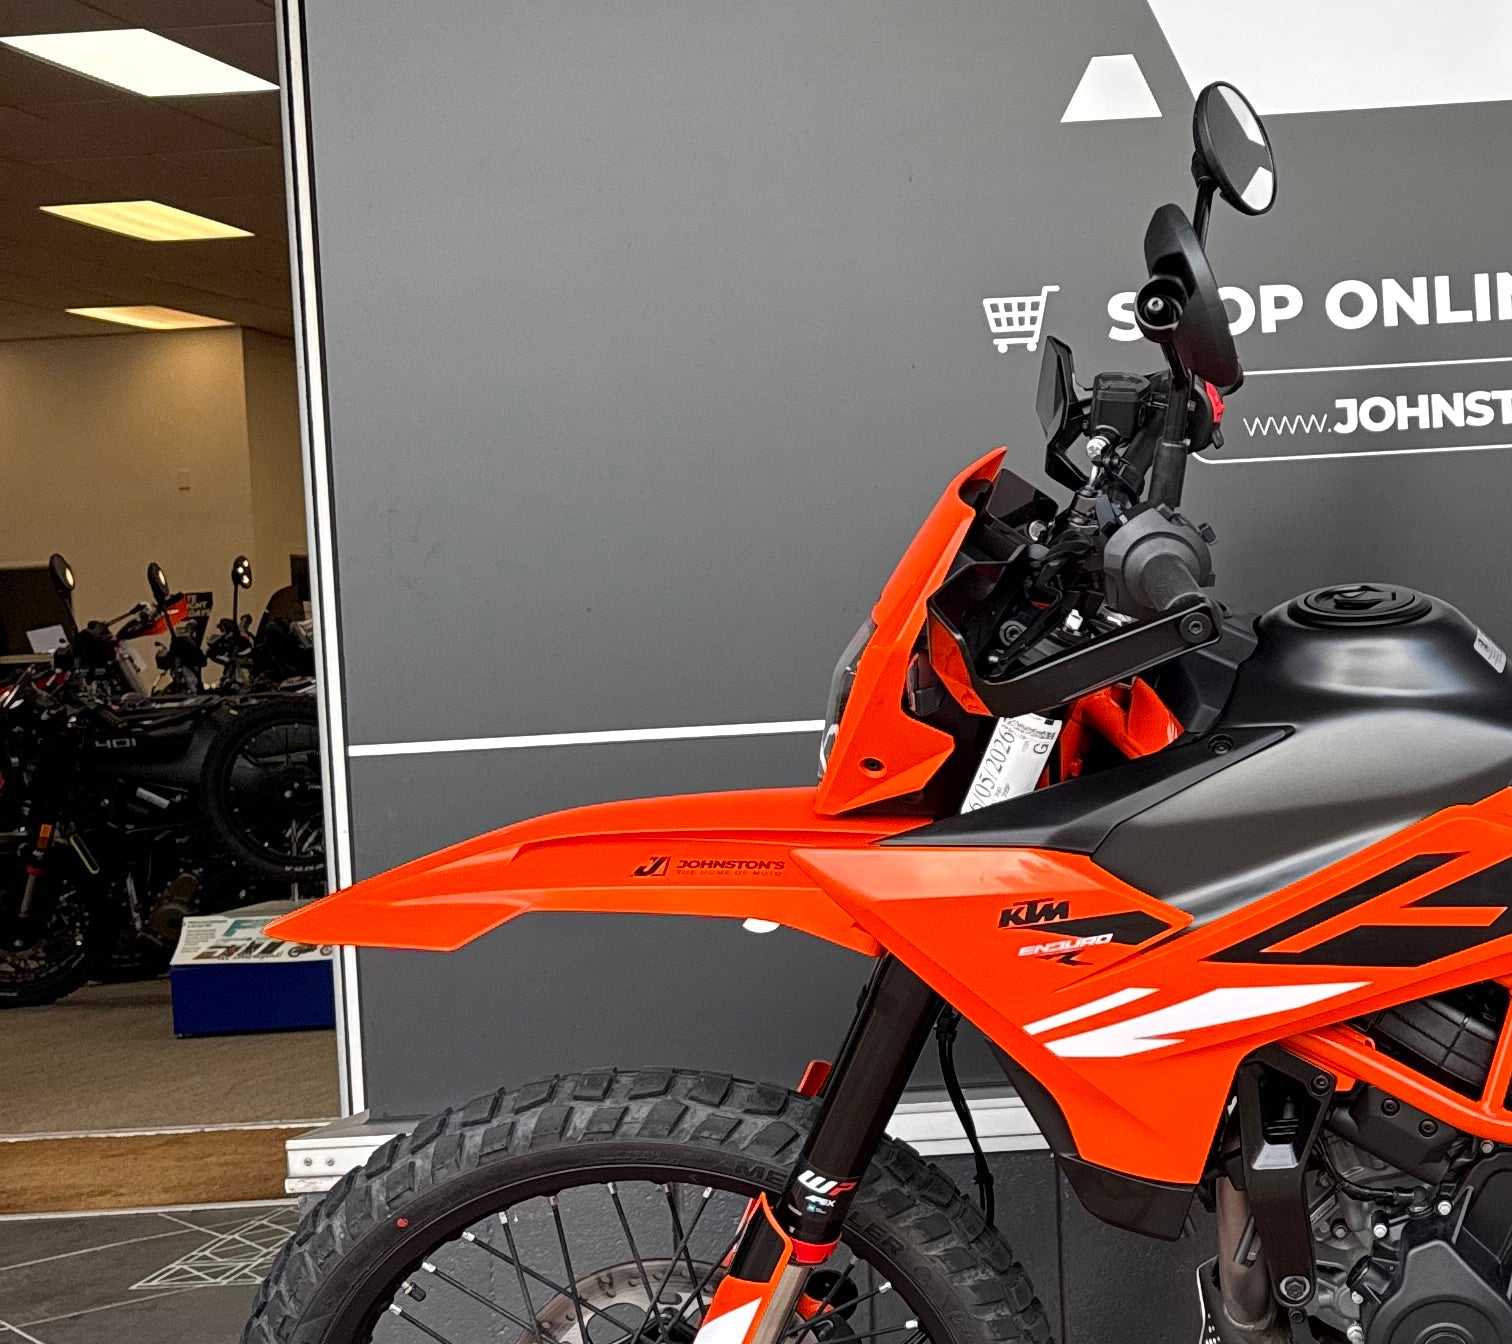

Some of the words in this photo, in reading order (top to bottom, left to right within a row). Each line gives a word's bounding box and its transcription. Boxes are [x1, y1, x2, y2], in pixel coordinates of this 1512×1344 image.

[1106, 283, 1304, 342] SOP
[676, 859, 785, 870] JOHNSTON'S
[998, 897, 1070, 928] KTM
[1018, 933, 1114, 957] ENDURO
